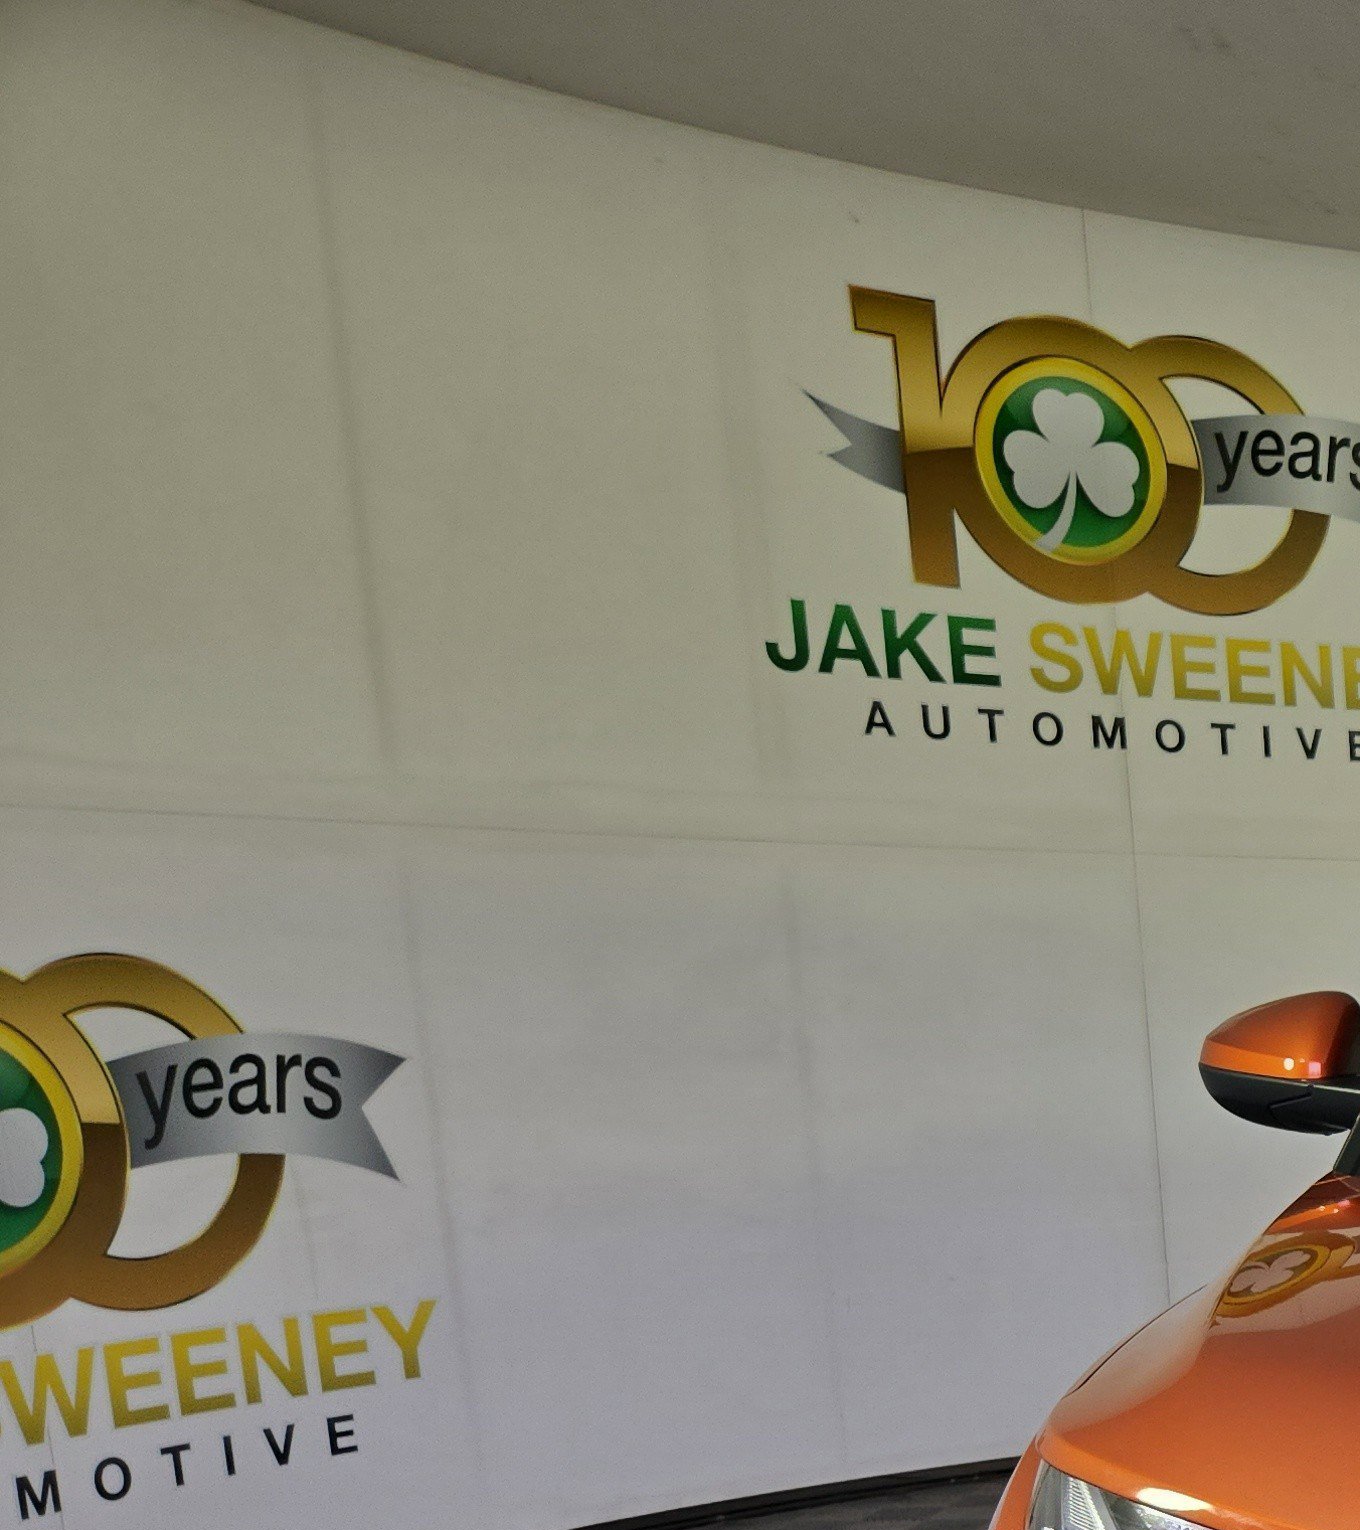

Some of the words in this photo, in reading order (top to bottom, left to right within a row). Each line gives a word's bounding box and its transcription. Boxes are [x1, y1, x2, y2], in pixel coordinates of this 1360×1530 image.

[848, 285, 1331, 616] 100
[765, 600, 1001, 687] JAKE
[136, 1052, 342, 1150] years
[0, 1299, 436, 1446] WEENEY
[15, 1414, 359, 1520] MOTIVE
